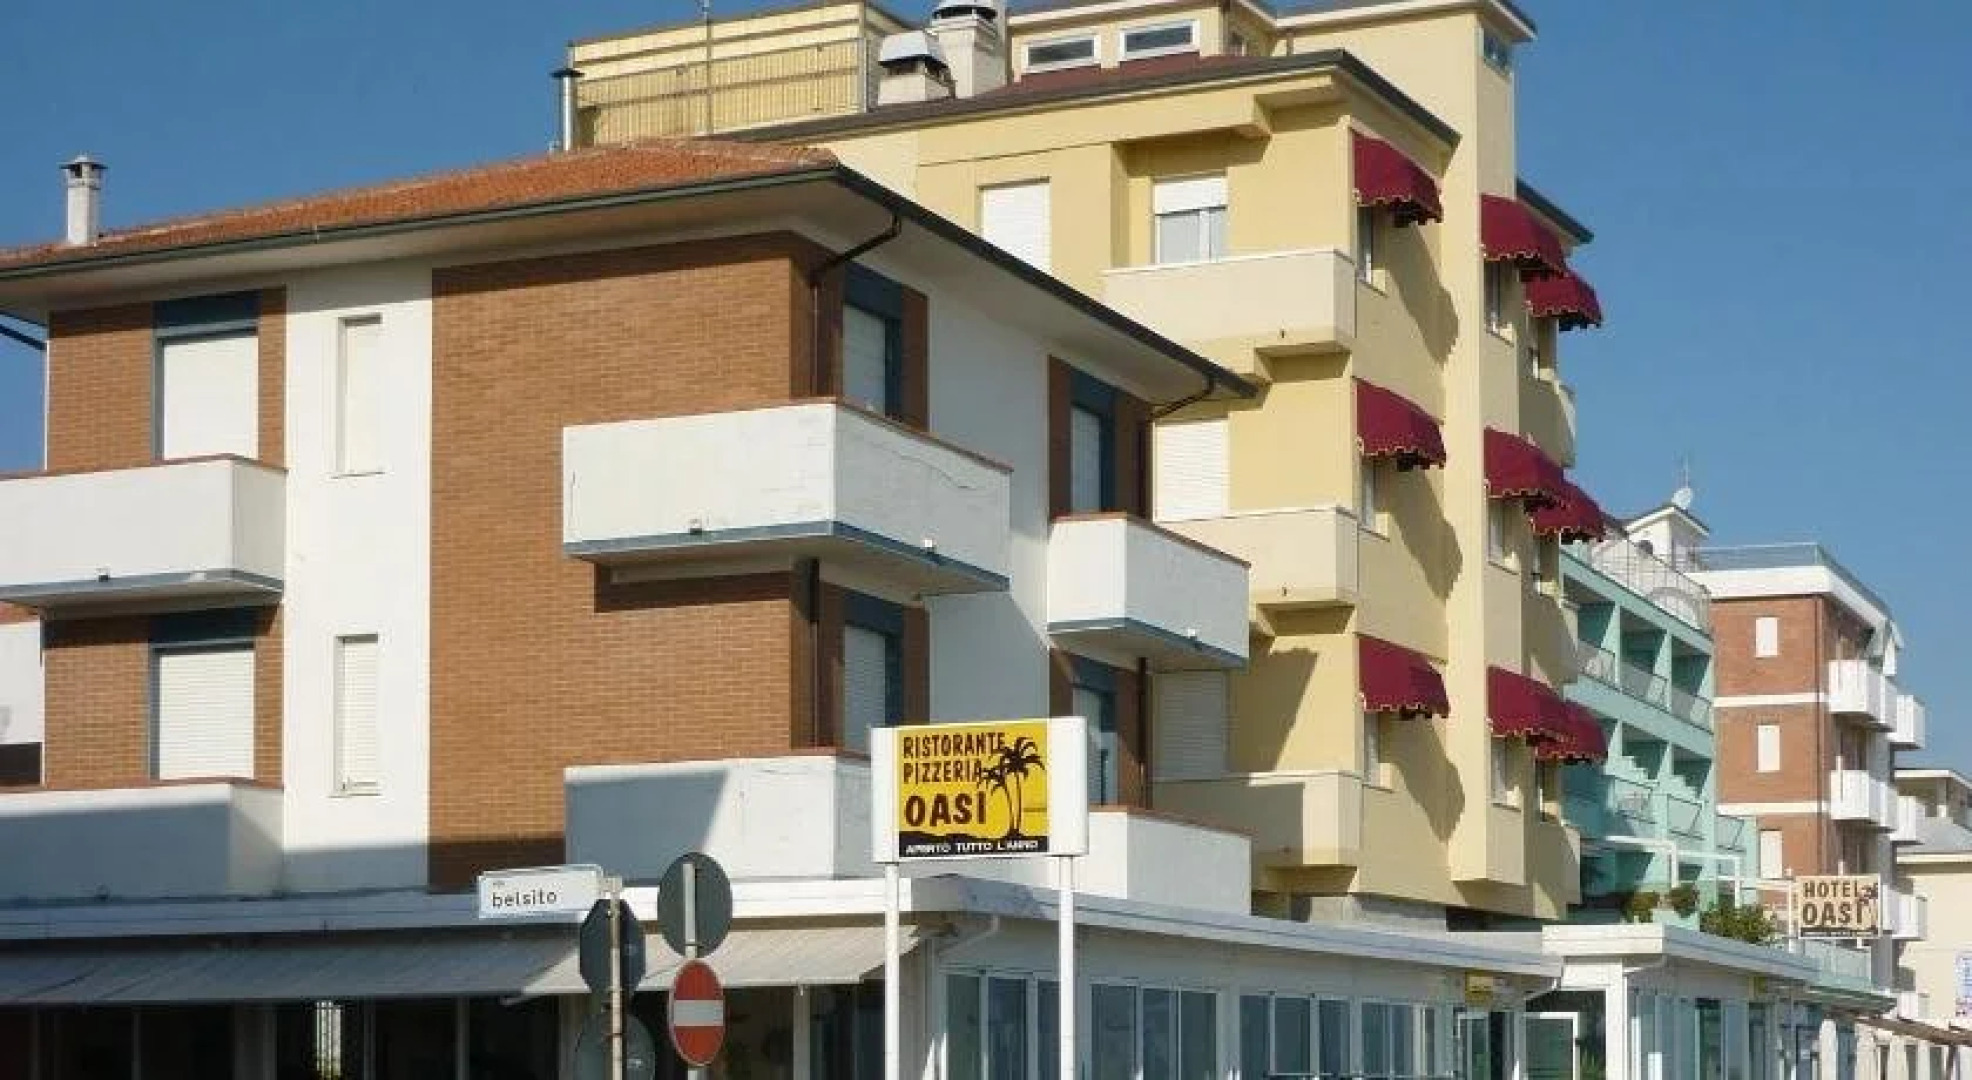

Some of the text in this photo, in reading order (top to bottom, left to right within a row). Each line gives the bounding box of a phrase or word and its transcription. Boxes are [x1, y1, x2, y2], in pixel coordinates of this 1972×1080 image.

[903, 732, 1005, 757] RISTORANTE
[903, 759, 982, 783] PIZZERIA
[904, 791, 986, 826] OASI
[956, 842, 991, 852] TUTTO
[492, 888, 557, 907] belsito
[1803, 881, 1860, 898] HOTEL
[1802, 901, 1863, 925] OASI
